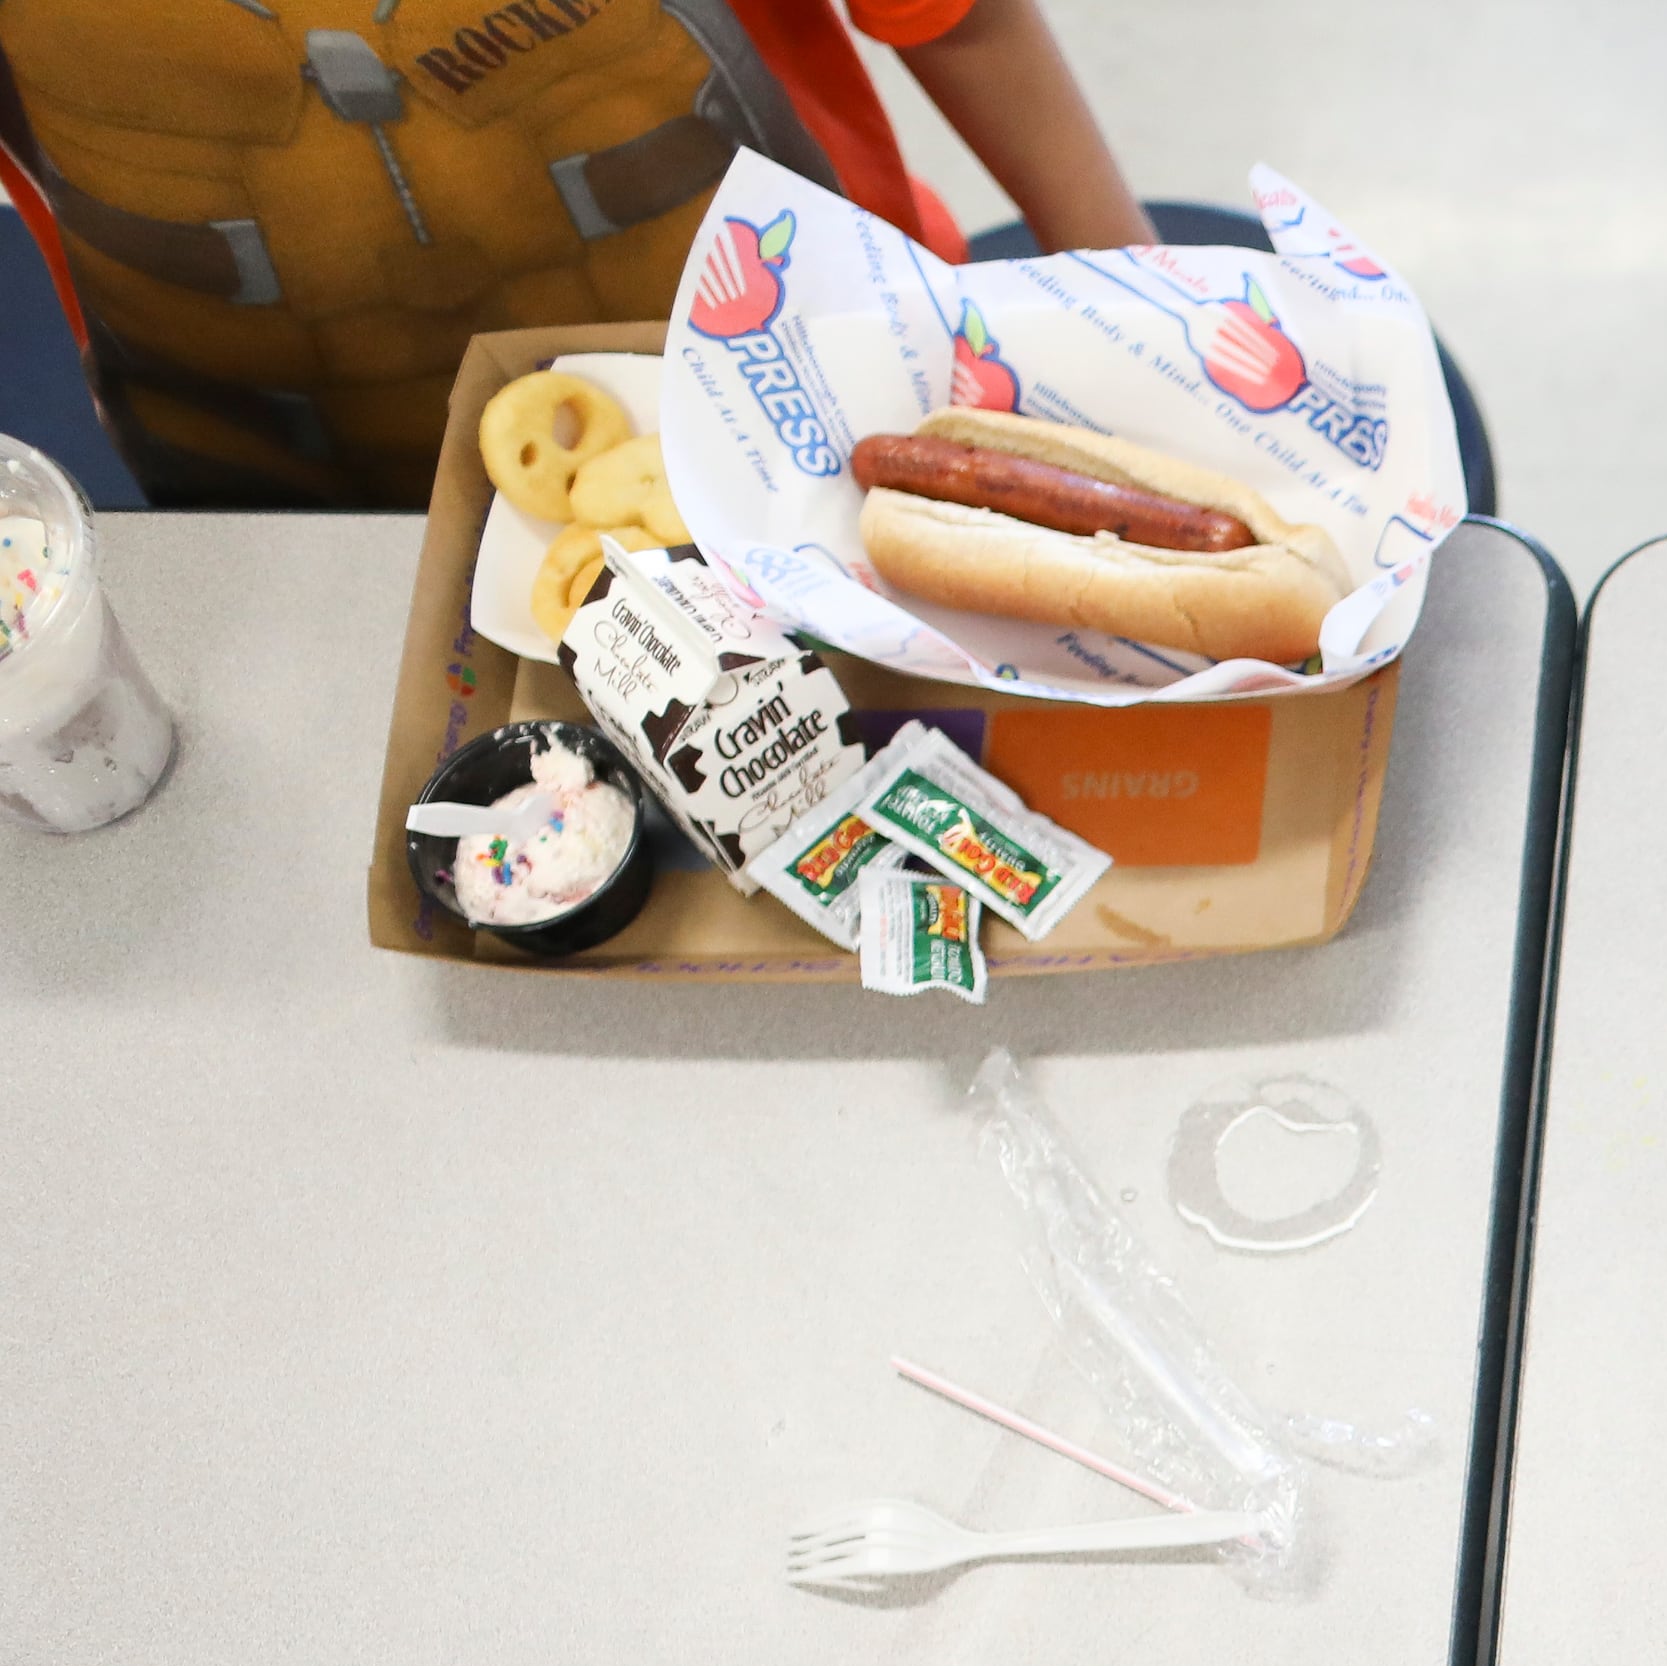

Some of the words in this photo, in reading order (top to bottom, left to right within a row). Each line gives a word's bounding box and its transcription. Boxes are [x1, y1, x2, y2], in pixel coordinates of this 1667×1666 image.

[682, 347, 724, 400] Child
[725, 332, 842, 477] PRESS
[1080, 304, 1127, 346] Body
[1214, 401, 1252, 436] One
[1252, 430, 1307, 477] Child
[636, 621, 682, 677] Chocolate
[713, 680, 793, 761] Cravin'
[717, 708, 828, 799] Chocolate
[1061, 769, 1200, 800] GRAINS
